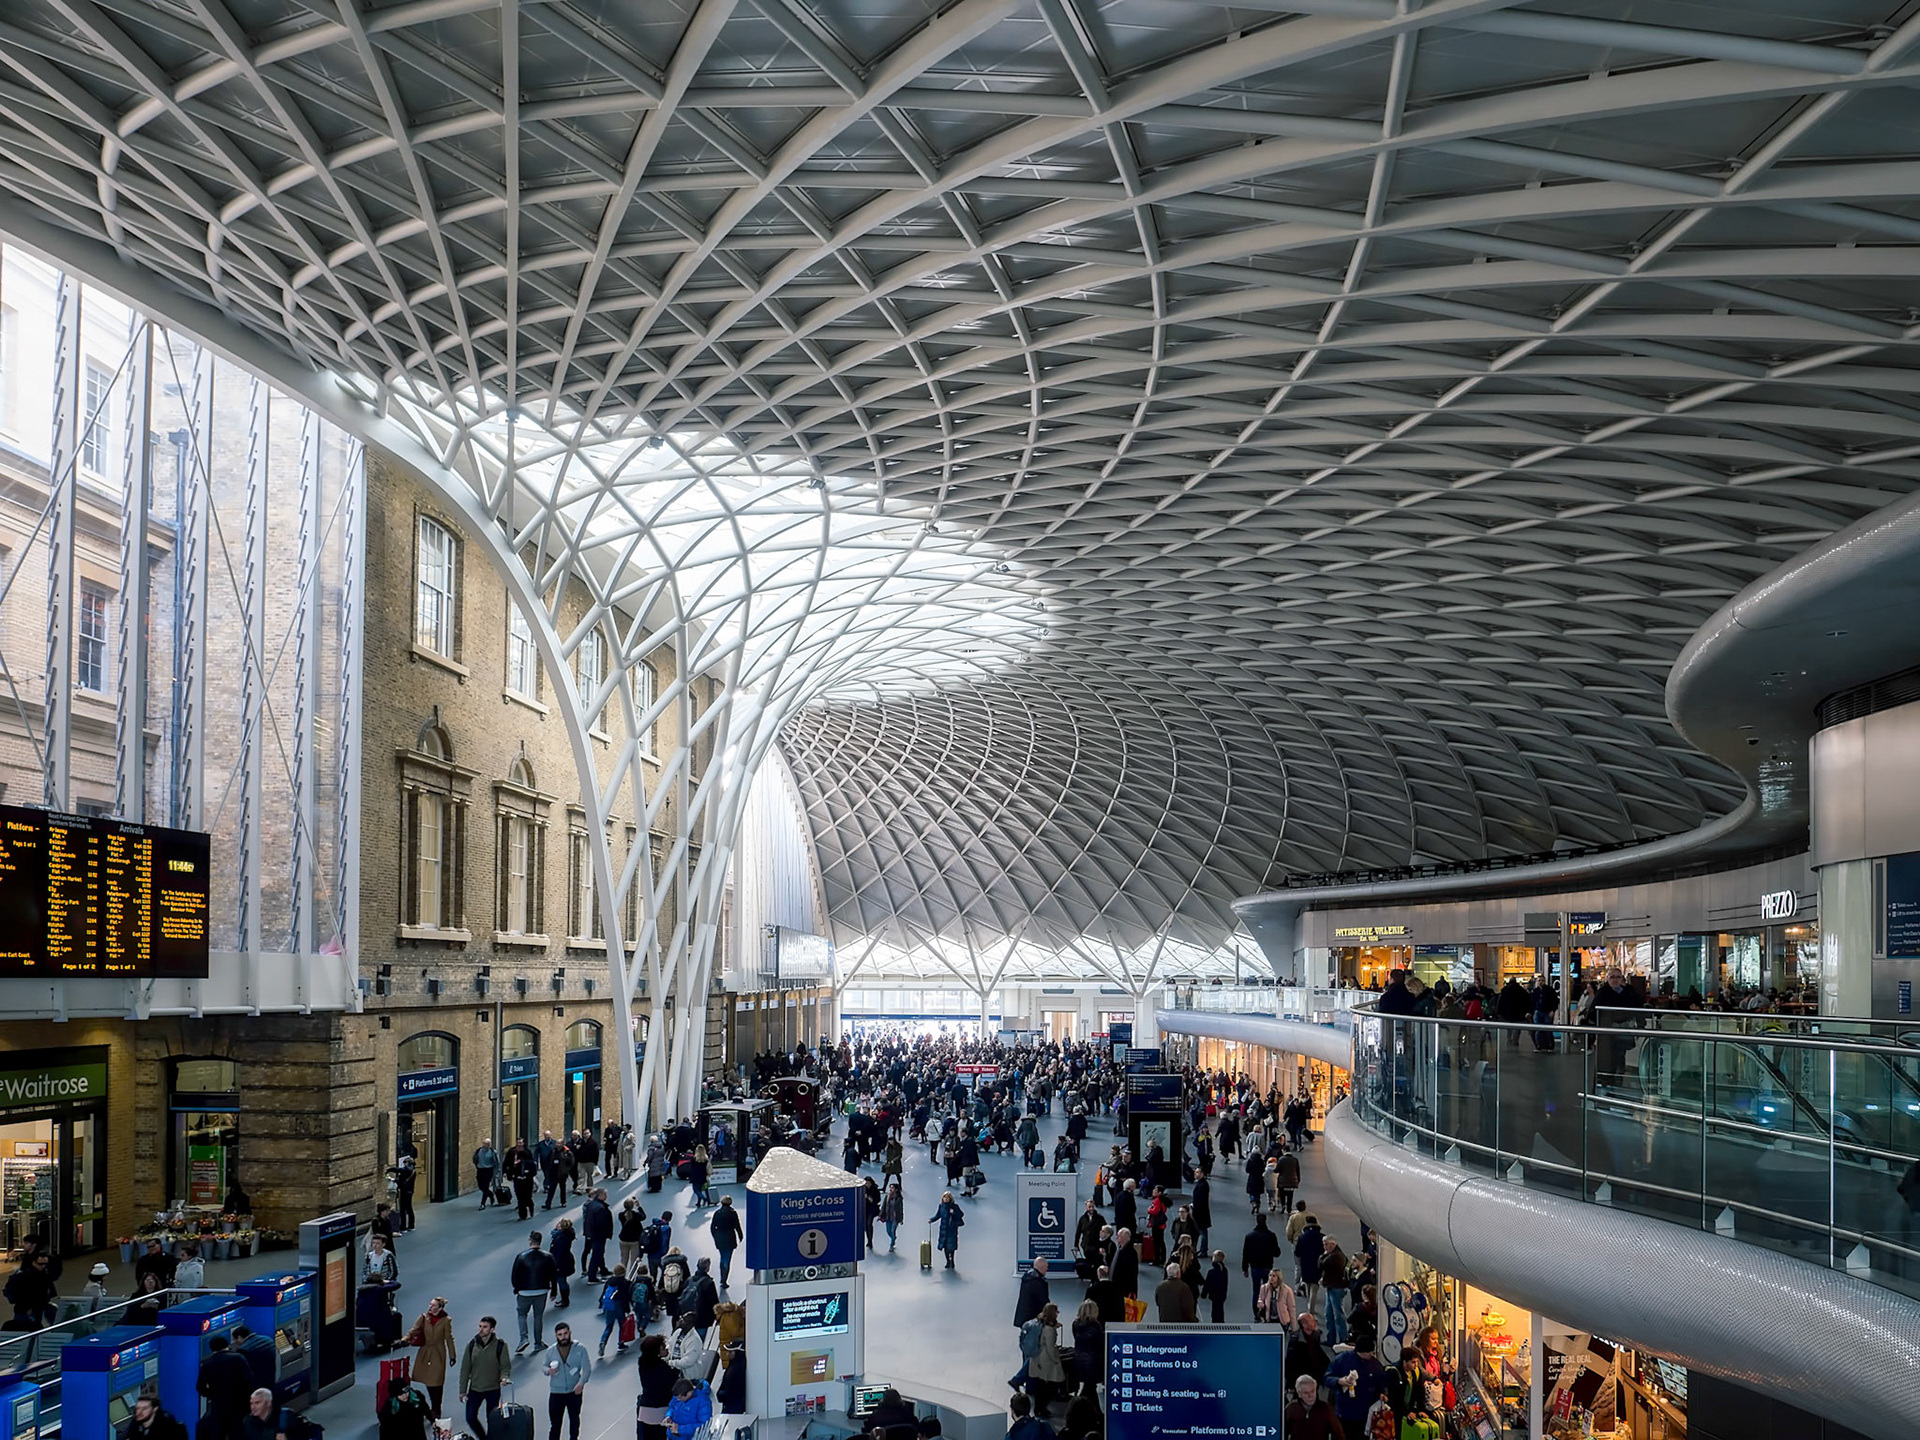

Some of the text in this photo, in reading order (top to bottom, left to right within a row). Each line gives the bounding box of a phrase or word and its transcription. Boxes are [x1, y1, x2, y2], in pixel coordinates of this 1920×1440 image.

[7, 821, 34, 832] Platform
[119, 824, 144, 835] Arrivals
[1762, 890, 1793, 920] PREZZO
[1335, 926, 1404, 936] PATISSERIE VALERIE
[5, 1073, 89, 1100] Waitrose
[416, 1079, 433, 1087] Platforms
[781, 1195, 844, 1209] King's Cross
[1136, 1345, 1187, 1355] Underground
[1136, 1359, 1173, 1368] Platforms
[1548, 1354, 1592, 1364] THE REAL DEAL
[1548, 1365, 1586, 1376] Cornish through
[1135, 1374, 1155, 1382] Taxis
[1558, 1374, 1577, 1384] through
[1136, 1389, 1161, 1398] Dining
[1162, 1389, 1169, 1397] &
[1170, 1390, 1199, 1399] seating
[1135, 1403, 1163, 1412] Tickets
[1190, 1426, 1228, 1435] Platforms
[1229, 1426, 1235, 1435] 0
[1247, 1426, 1252, 1435] 8
